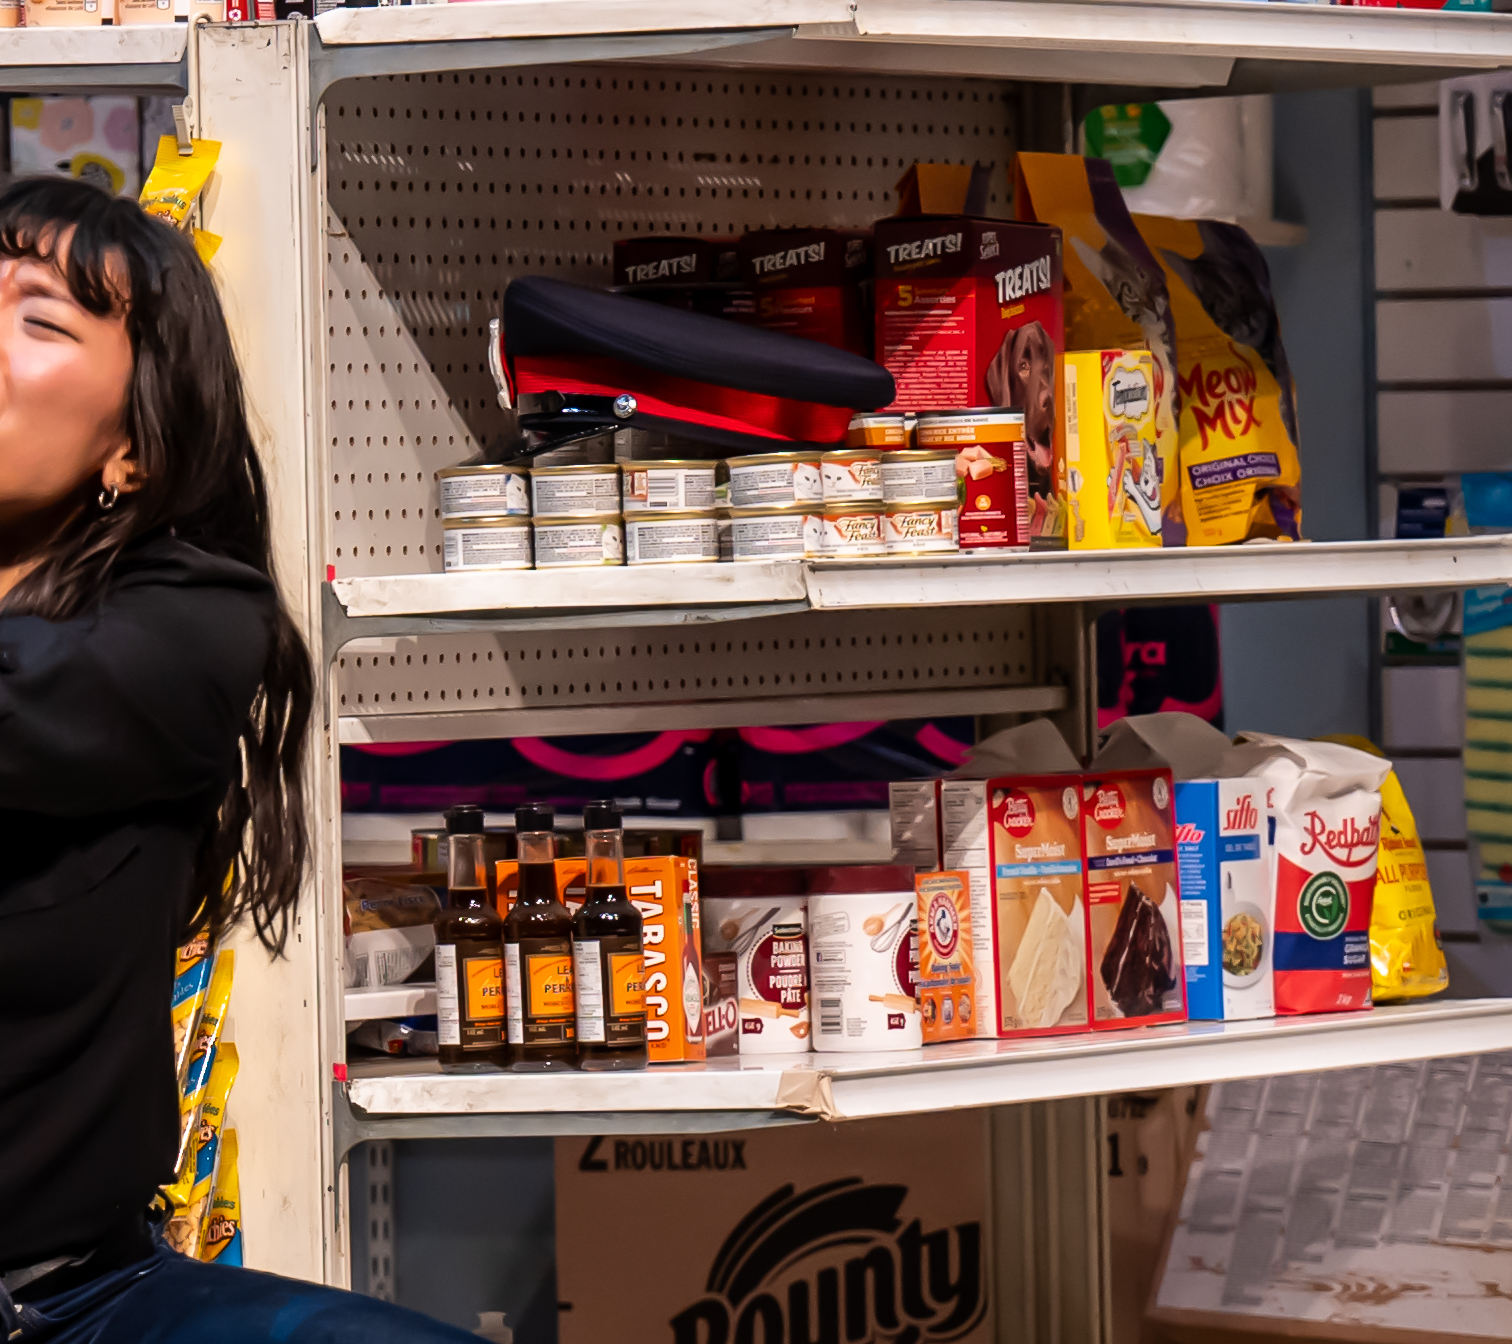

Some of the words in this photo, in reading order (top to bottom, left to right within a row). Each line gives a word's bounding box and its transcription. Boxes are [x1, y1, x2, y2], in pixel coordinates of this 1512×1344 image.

[751, 241, 826, 276] TREATS!
[887, 232, 963, 264] TREATS!
[625, 253, 697, 284] TREATS!
[995, 255, 1051, 304] TREATS!
[898, 285, 913, 307] 5
[900, 513, 937, 530] Fancy
[903, 526, 938, 541] Feast
[629, 879, 671, 1043] TABASCO
[780, 988, 802, 1004] PÂTE
[705, 999, 737, 1037] ELL-O
[614, 1138, 747, 1171] ROULEAUX
